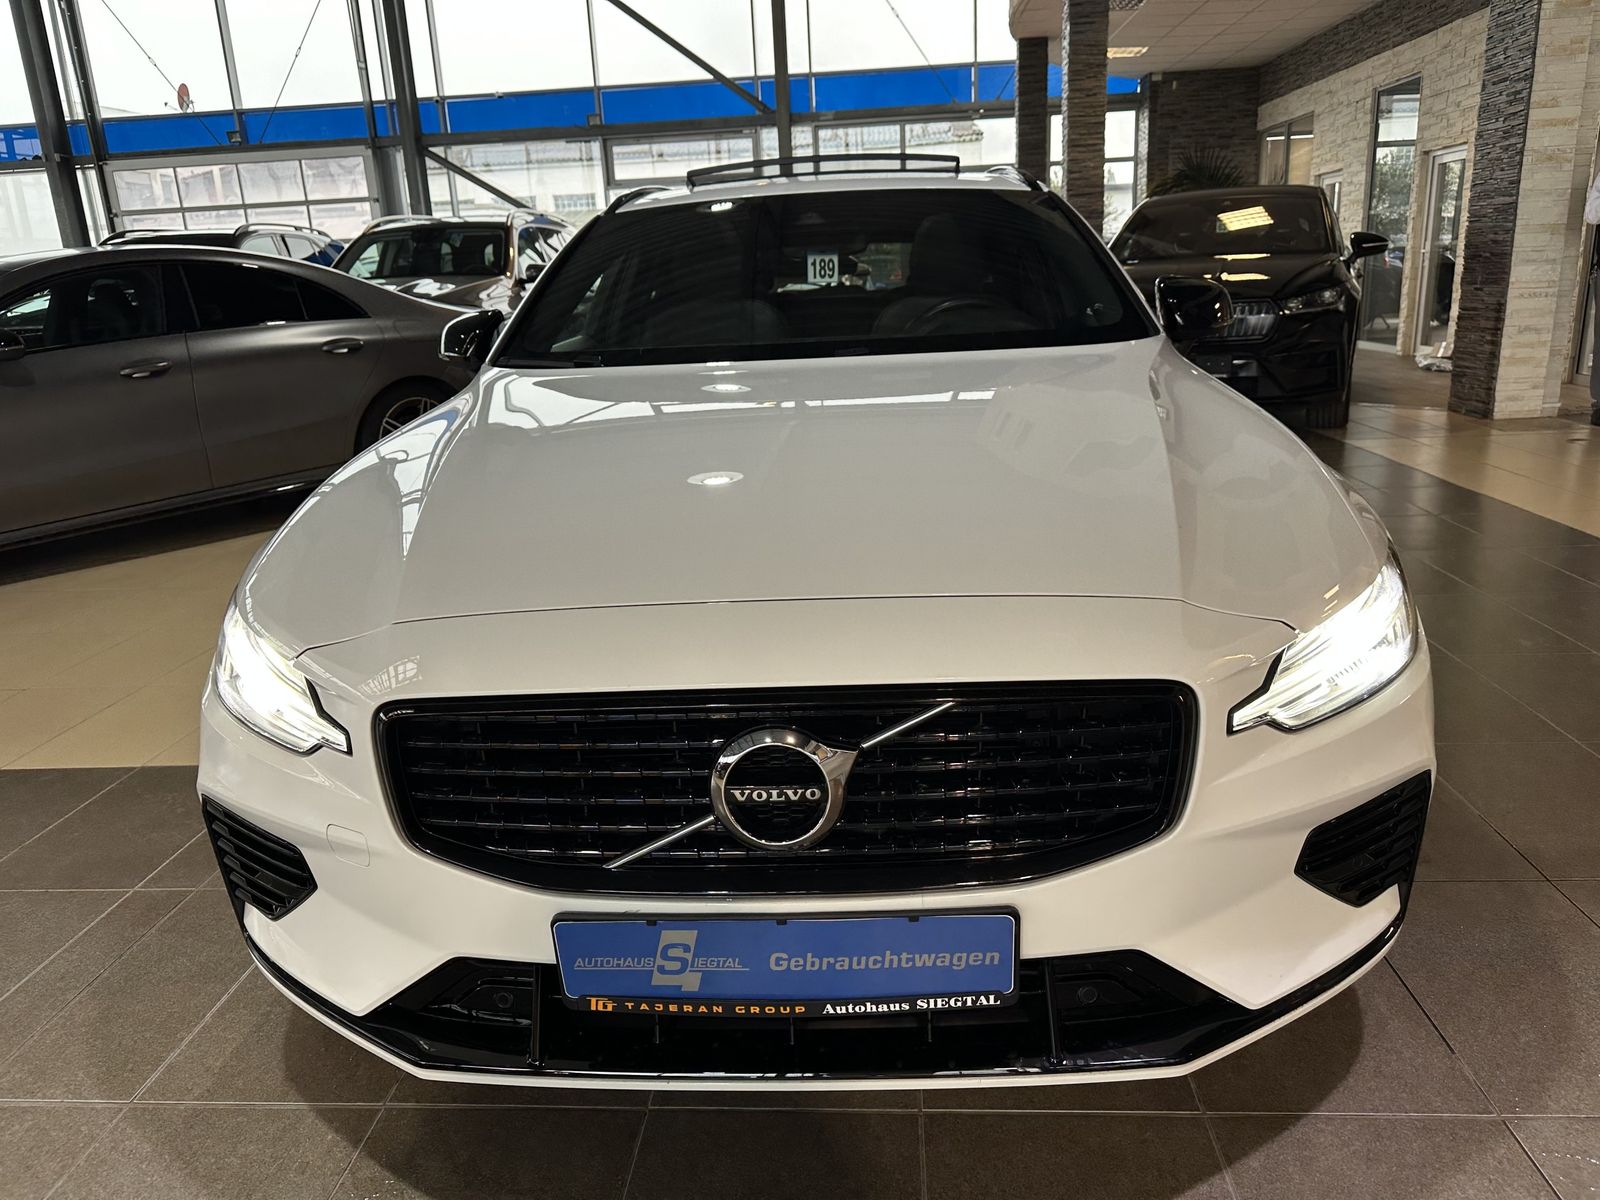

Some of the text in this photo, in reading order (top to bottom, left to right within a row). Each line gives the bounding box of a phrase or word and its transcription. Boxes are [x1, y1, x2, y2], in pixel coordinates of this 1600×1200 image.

[811, 258, 835, 279] 189
[730, 788, 821, 801] VOLVO
[573, 956, 655, 970] AUTOHAUS
[768, 950, 1001, 973] Gebrauchtwagen
[624, 1002, 724, 1014] TAJERAN
[735, 1005, 806, 1015] GROUP
[822, 994, 1001, 1015] Autohaus SIEGTAL
